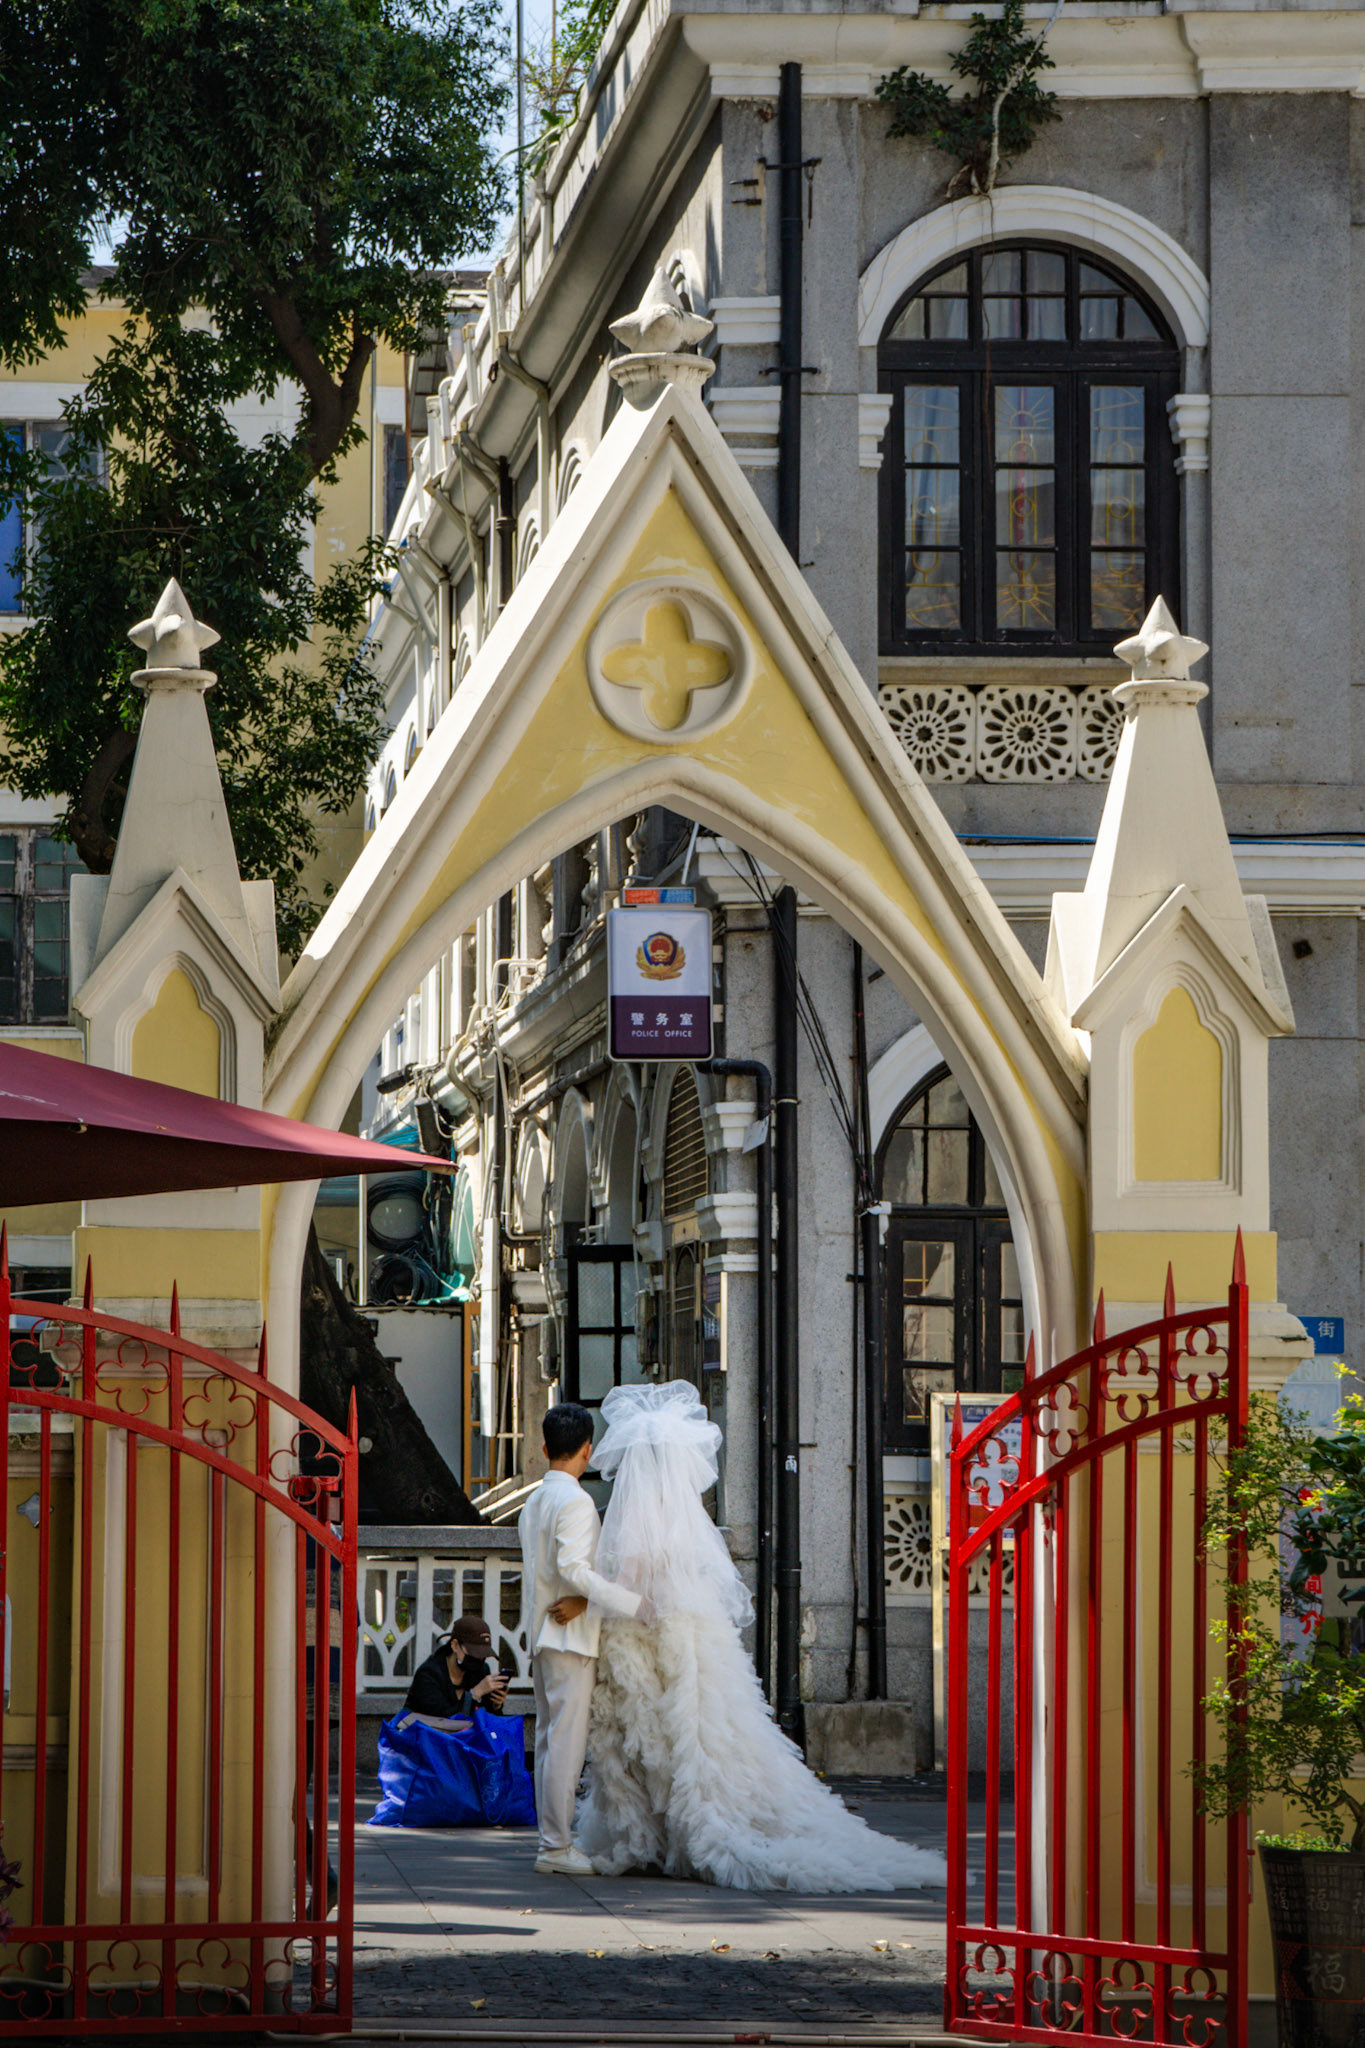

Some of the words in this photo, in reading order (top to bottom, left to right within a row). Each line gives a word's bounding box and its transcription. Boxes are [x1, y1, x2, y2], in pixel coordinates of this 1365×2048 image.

[631, 1012, 693, 1026] 警务室
[631, 1030, 659, 1038] POLICE
[664, 1030, 692, 1038] OFFICE
[1304, 1951, 1346, 1995] 福
